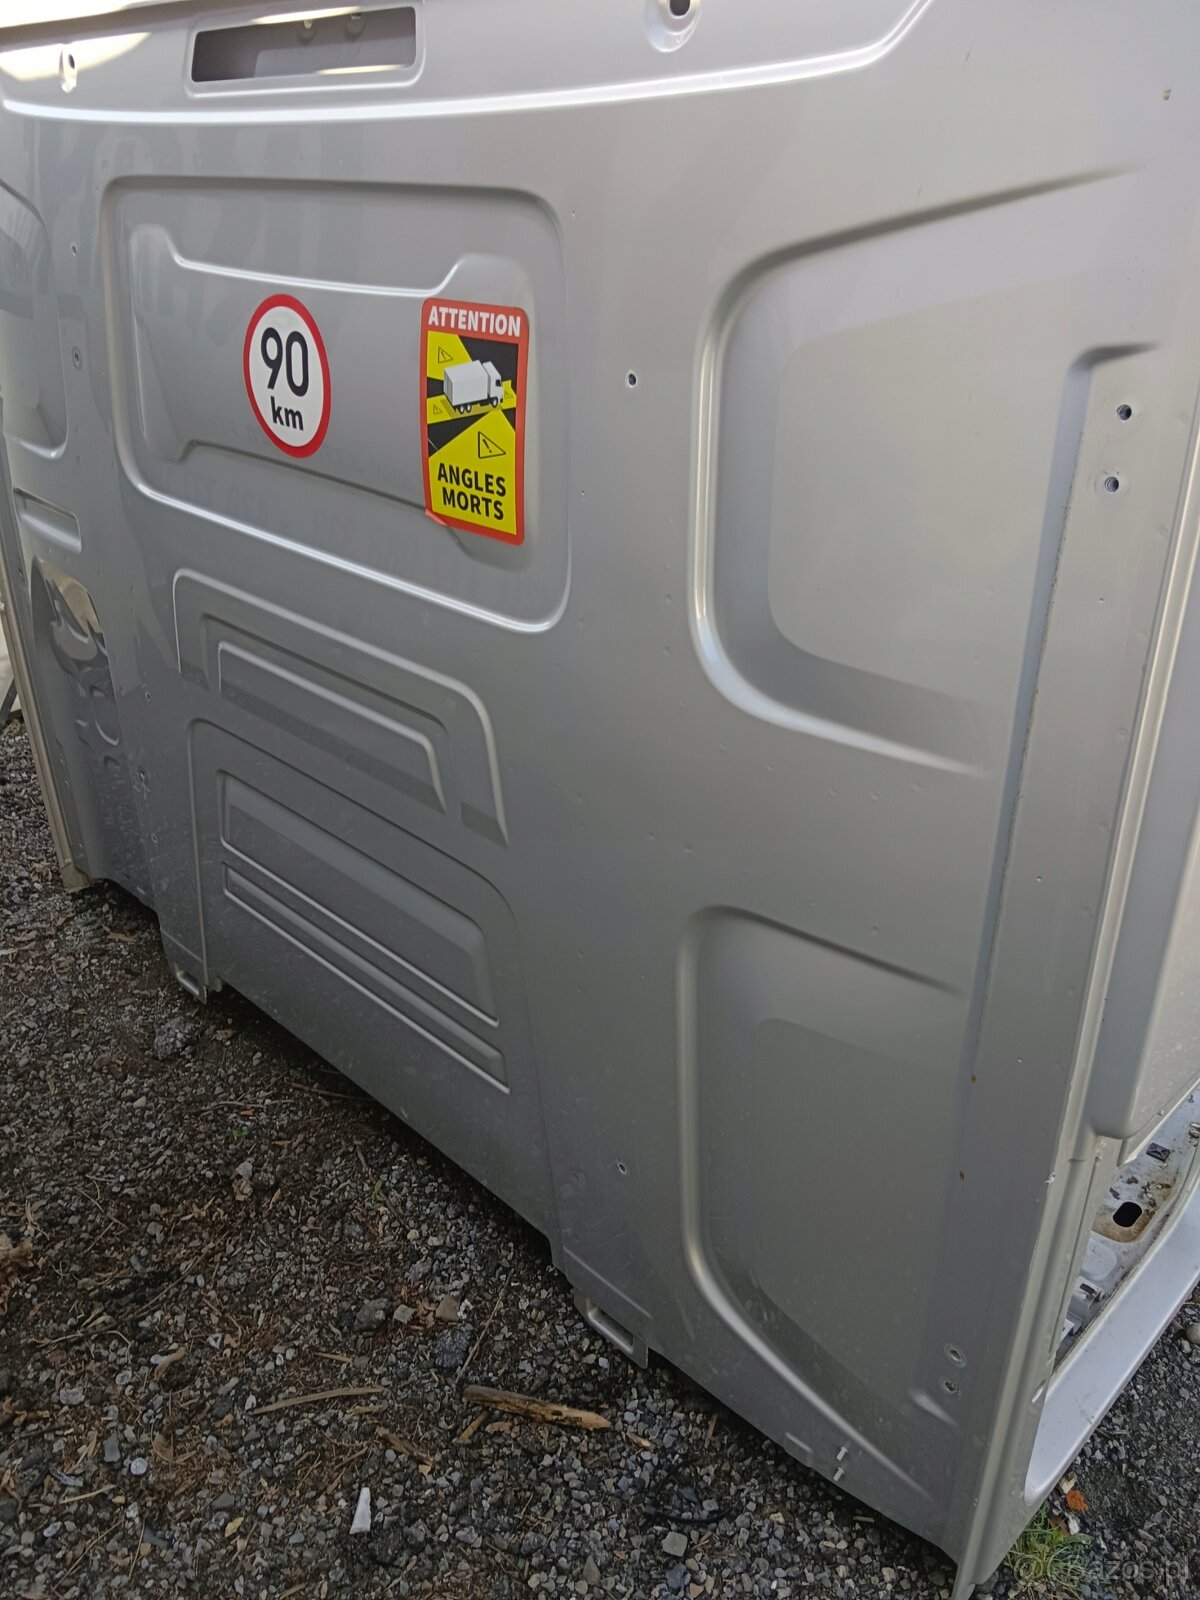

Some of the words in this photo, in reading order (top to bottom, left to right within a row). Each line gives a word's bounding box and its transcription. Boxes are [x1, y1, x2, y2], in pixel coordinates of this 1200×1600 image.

[428, 305, 521, 337] ATTENTION
[260, 327, 309, 397] 90
[270, 396, 304, 431] km
[437, 462, 507, 498] ANGLES
[442, 486, 504, 521] MORTS
